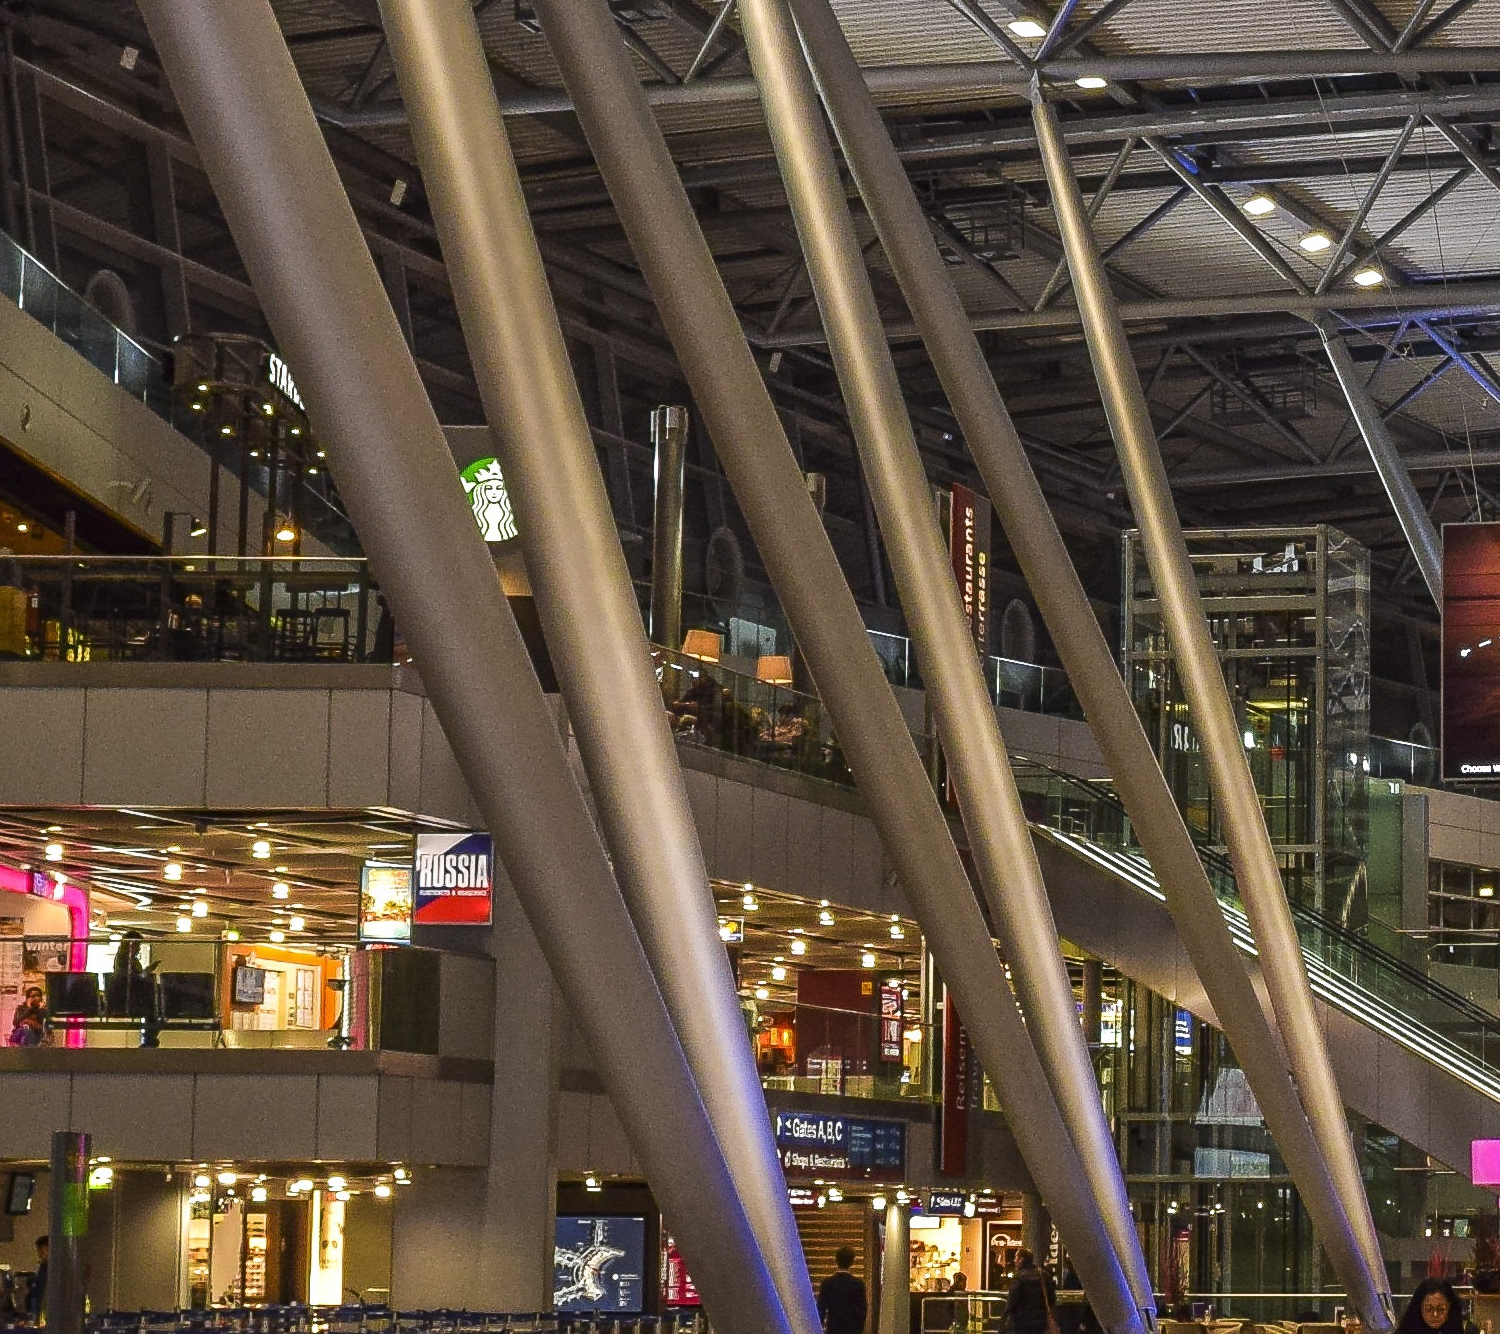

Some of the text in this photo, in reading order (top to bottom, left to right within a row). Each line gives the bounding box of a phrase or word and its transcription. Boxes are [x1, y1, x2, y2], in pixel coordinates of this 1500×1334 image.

[419, 853, 489, 888] RUSSIA
[955, 1026, 966, 1110] Reisem
[793, 1118, 816, 1139] Gates
